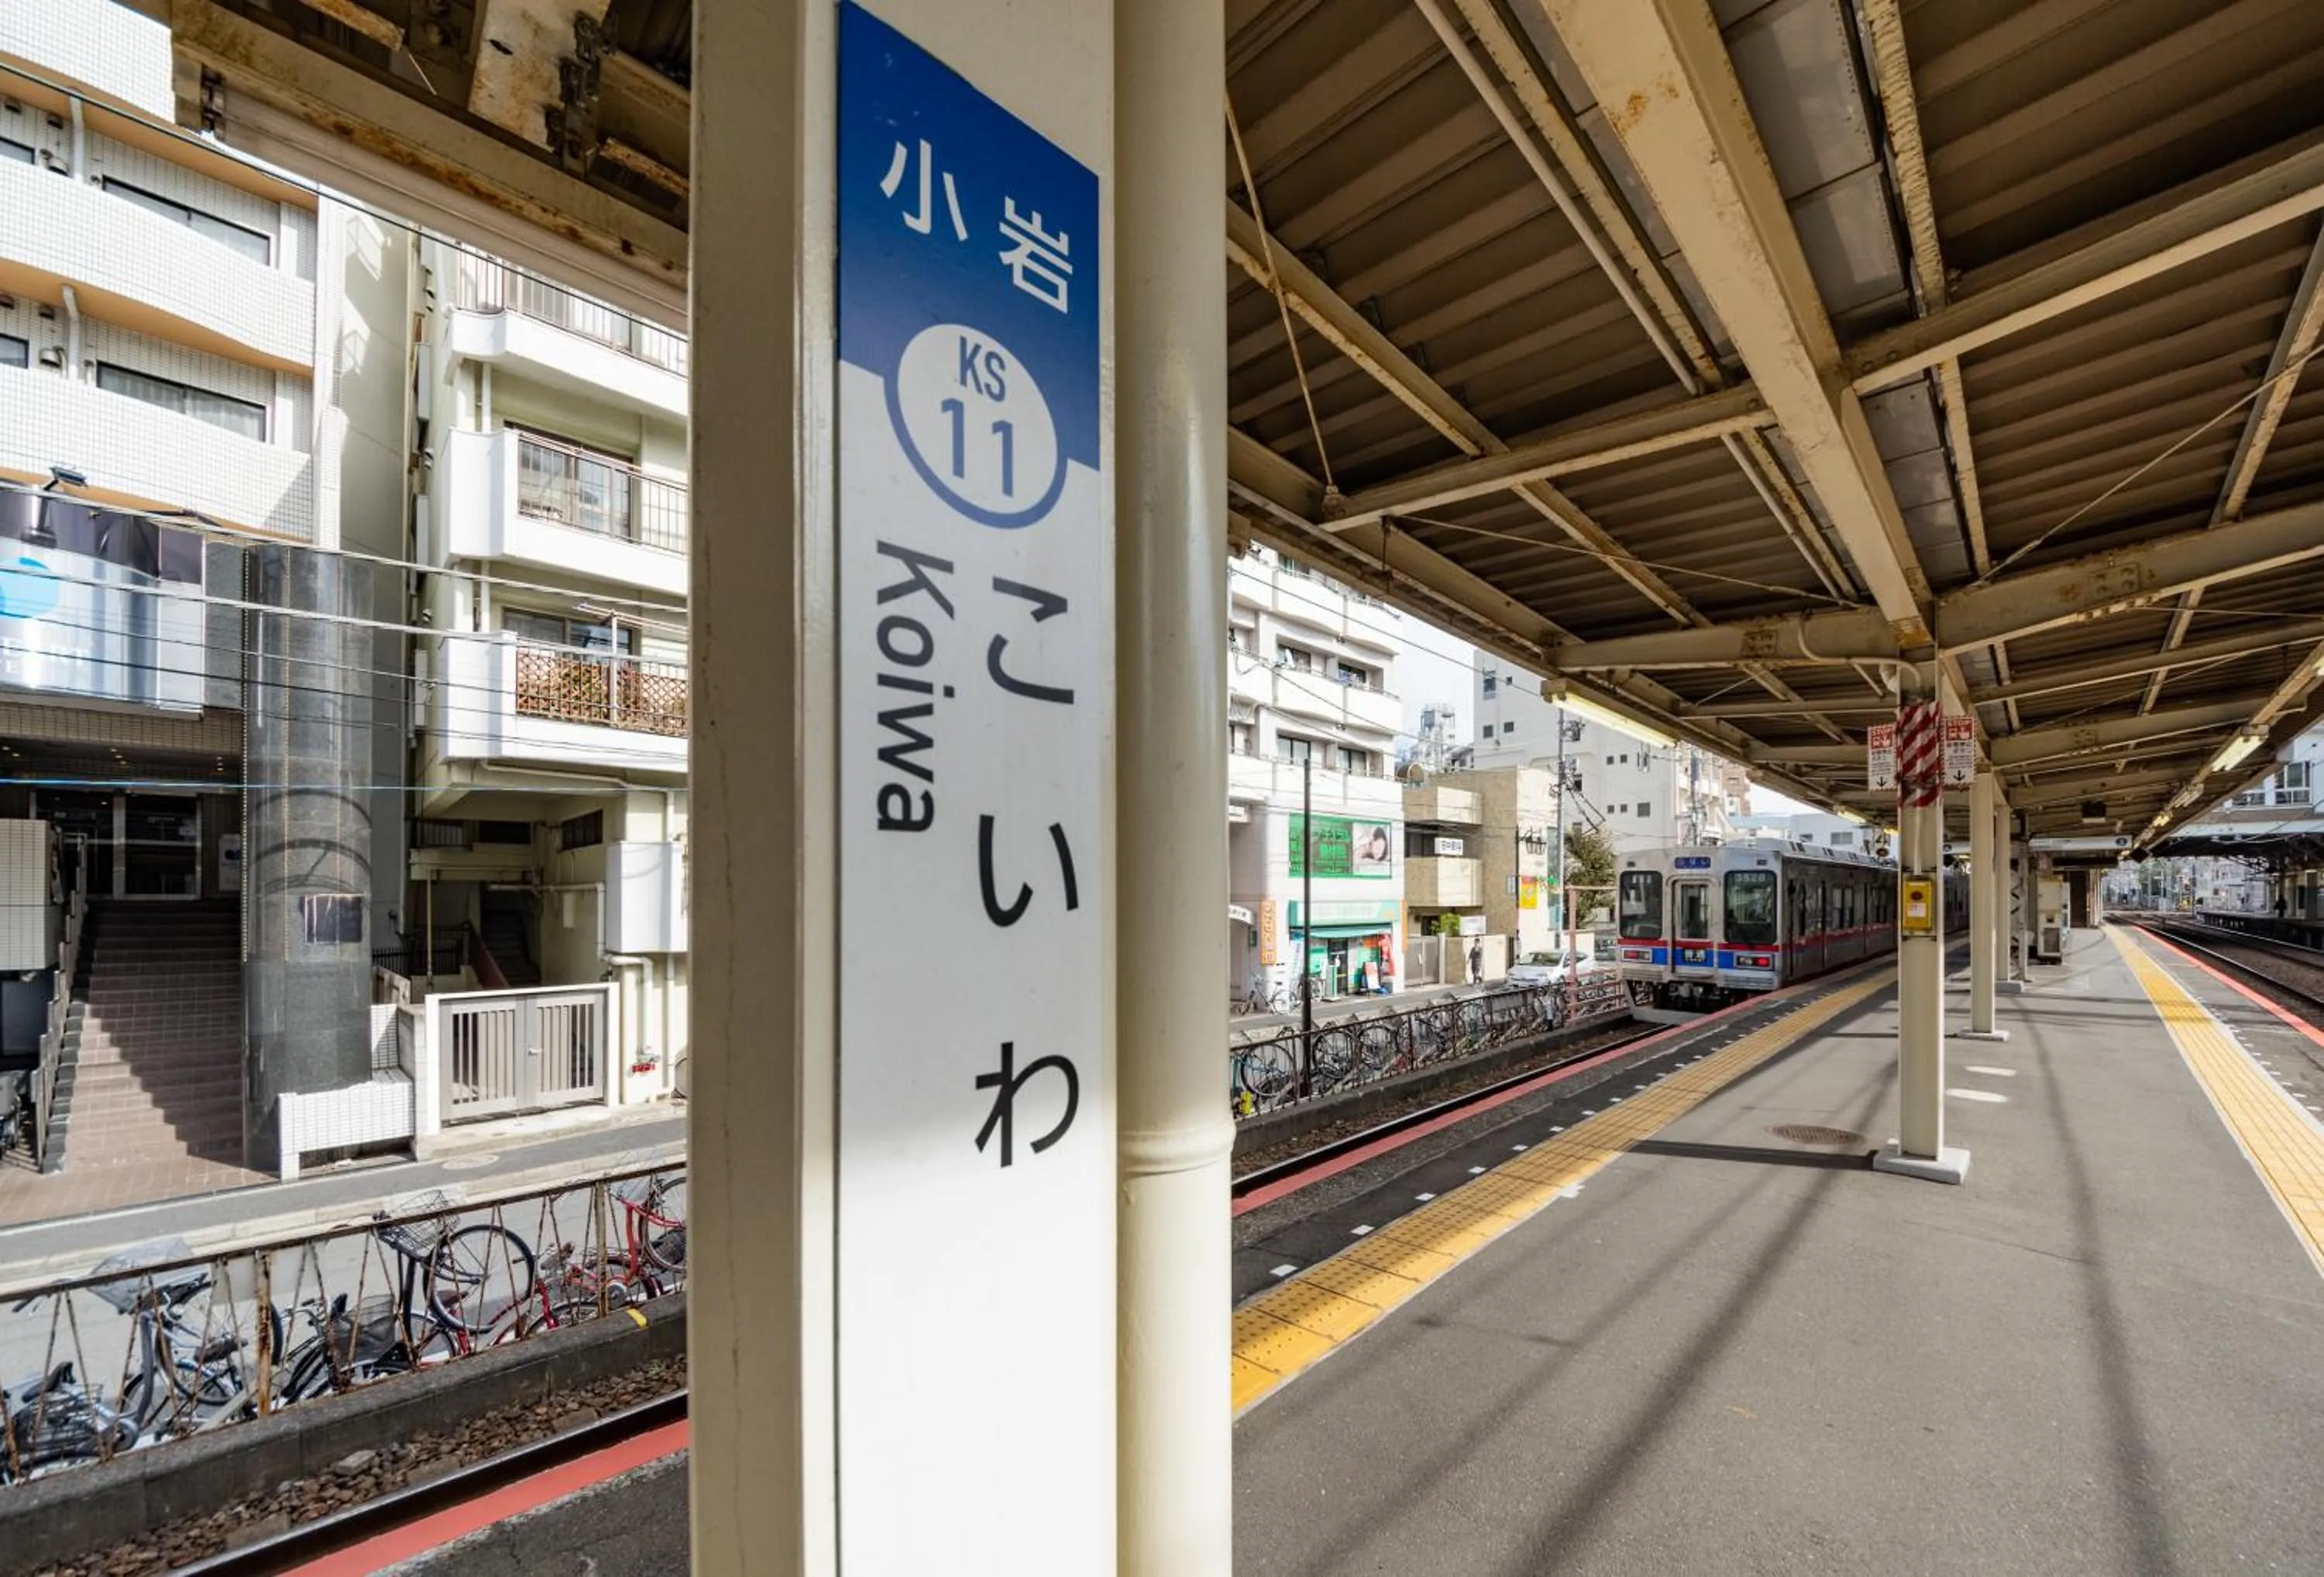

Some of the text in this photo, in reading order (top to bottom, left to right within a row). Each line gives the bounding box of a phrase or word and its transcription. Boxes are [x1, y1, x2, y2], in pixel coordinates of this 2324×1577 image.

[880, 138, 1073, 314] 小岩
[941, 397, 1013, 496] 11
[959, 335, 1006, 402] KS
[876, 540, 955, 833] Koiwa
[975, 576, 1079, 1168] こいわ
